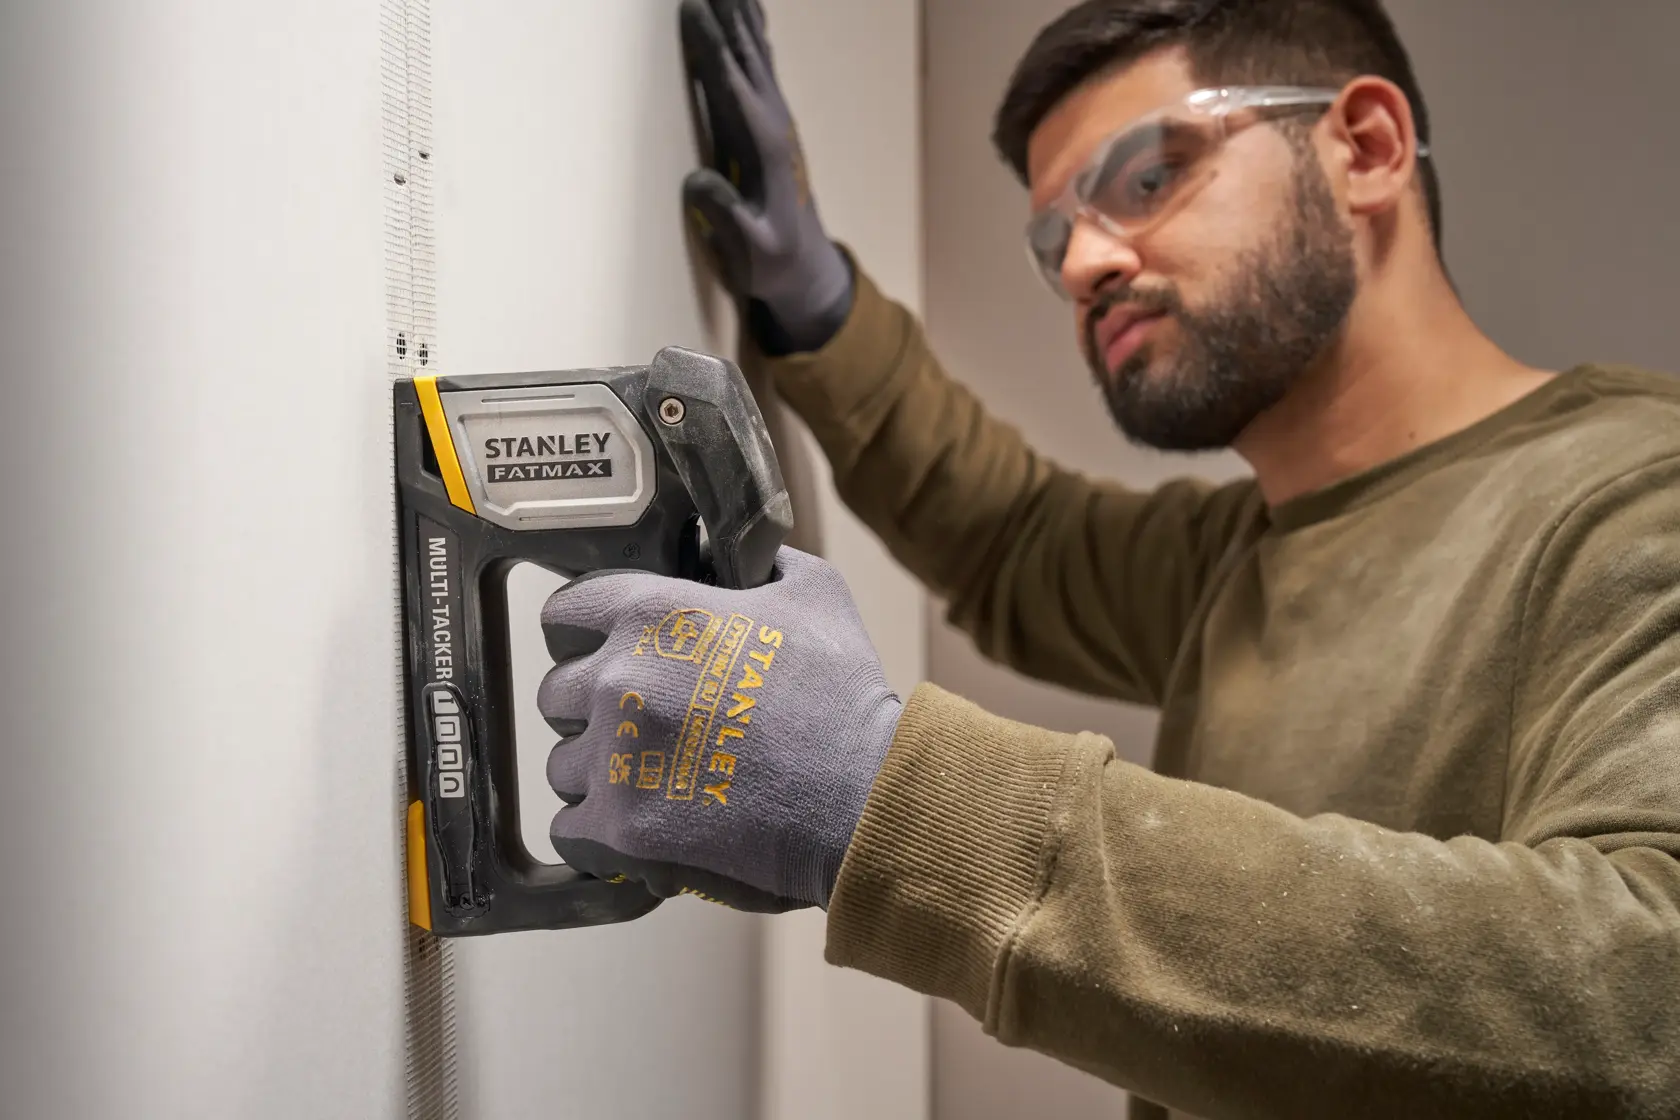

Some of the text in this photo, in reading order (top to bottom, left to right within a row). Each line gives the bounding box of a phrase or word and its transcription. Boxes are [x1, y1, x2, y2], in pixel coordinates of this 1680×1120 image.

[485, 432, 611, 459] STANLEY
[494, 462, 604, 480] FATMAX
[428, 537, 453, 680] MULTI-TACKER
[704, 625, 783, 805] STANLEY
